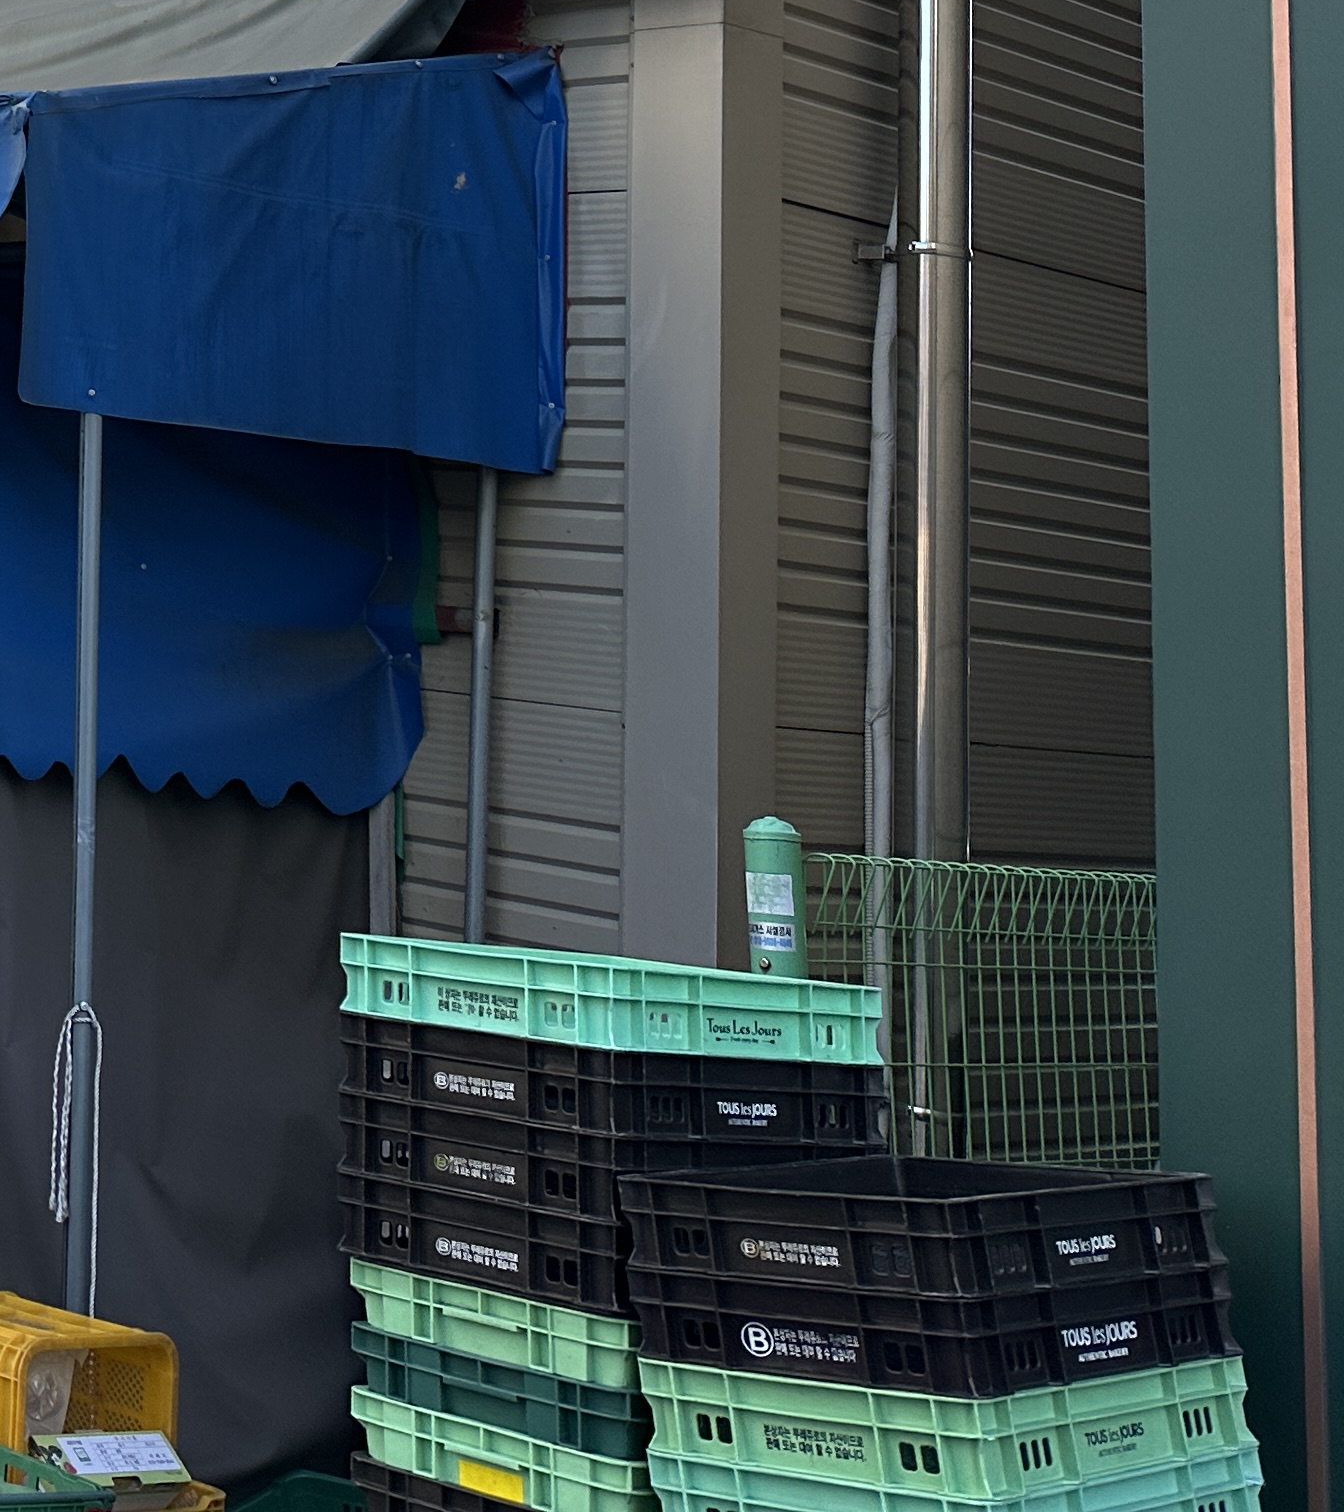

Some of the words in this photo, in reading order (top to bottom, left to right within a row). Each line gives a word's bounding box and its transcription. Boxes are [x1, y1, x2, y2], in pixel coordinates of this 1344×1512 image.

[707, 1018, 731, 1034] Tous
[733, 1020, 750, 1035] Les
[751, 1020, 782, 1037] Jours
[716, 1101, 740, 1115] TOUS
[740, 1102, 752, 1116] les
[751, 1103, 778, 1118] JOURS
[1056, 1239, 1079, 1255] TOUS
[1078, 1238, 1092, 1253] les
[1090, 1234, 1116, 1254] JOURS
[1061, 1328, 1092, 1347] TOUS
[1091, 1326, 1105, 1344] les
[1104, 1321, 1138, 1346] JOURS
[1085, 1429, 1108, 1447] TOUS
[1108, 1427, 1122, 1443] les
[1119, 1422, 1144, 1444] JOURS
